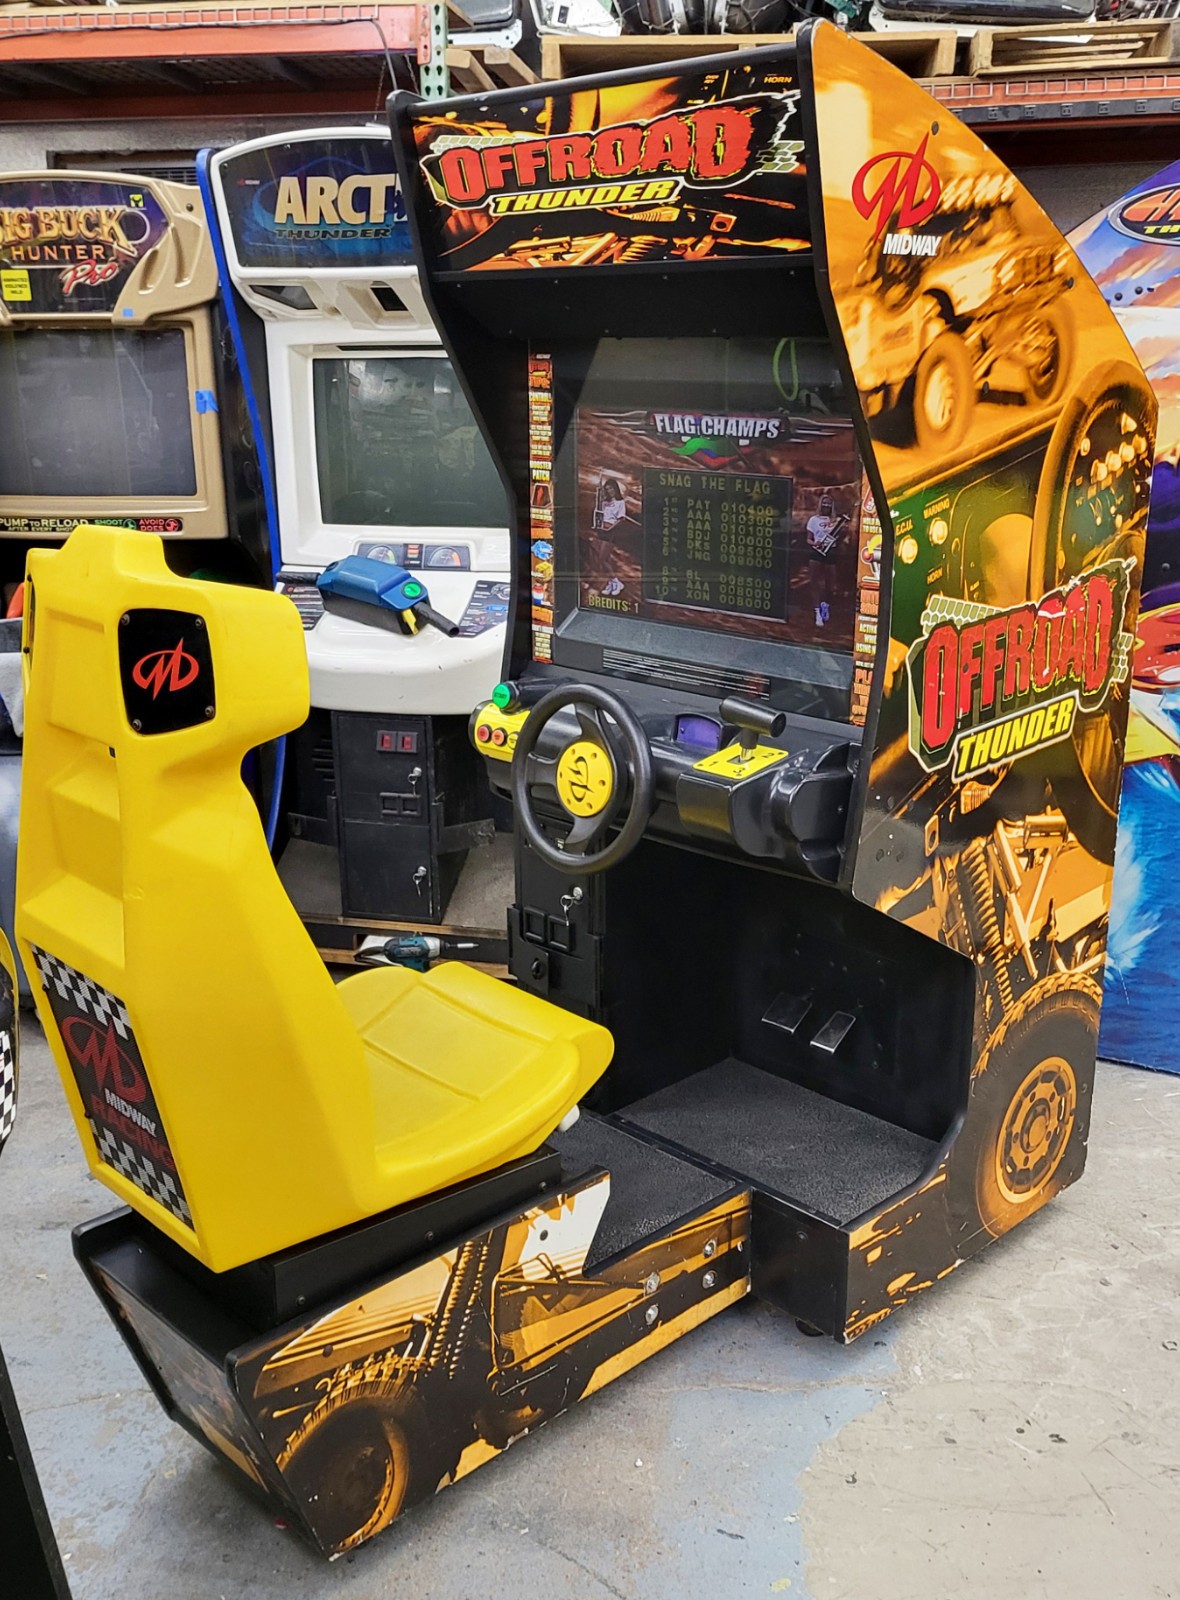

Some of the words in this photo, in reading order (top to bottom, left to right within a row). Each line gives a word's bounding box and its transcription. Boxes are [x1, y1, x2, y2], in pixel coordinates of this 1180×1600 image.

[440, 106, 758, 201] OFFROAD
[494, 180, 679, 213] THUNDER
[0, 207, 33, 245] IG
[37, 206, 138, 255] BUCK
[276, 228, 391, 239] THUNDER
[10, 245, 106, 261] HUNTER
[882, 233, 942, 256] MIDWAY
[60, 258, 119, 295] Pro
[654, 414, 695, 433] FLAG
[701, 416, 780, 438] CHAMPS
[660, 473, 692, 488] SNAG
[701, 476, 726, 490] THE
[735, 480, 771, 494] FLAG
[687, 499, 711, 509] PAT
[721, 502, 773, 516] 010400
[923, 498, 950, 519] WARNING
[0, 518, 28, 527] PUMP
[41, 519, 89, 528] RELOAD
[687, 509, 711, 520] AAA
[721, 513, 773, 526] 010300
[687, 520, 711, 530] AAA
[721, 523, 772, 537] 010100
[687, 529, 711, 540] BDJ
[720, 533, 772, 547] 010000
[687, 540, 710, 550] DKS
[720, 544, 772, 558] 009500
[686, 570, 701, 580] BL
[719, 574, 771, 589] 008500
[927, 568, 943, 585] HORN
[686, 580, 710, 591] AAA
[719, 584, 771, 599] 008000
[634, 603, 639, 614] 1
[686, 590, 710, 601] XON
[719, 594, 771, 610] 008000
[921, 574, 1116, 749] OFFROAD
[957, 697, 1077, 775] THUNDER
[104, 1088, 157, 1138] MIDWAY
